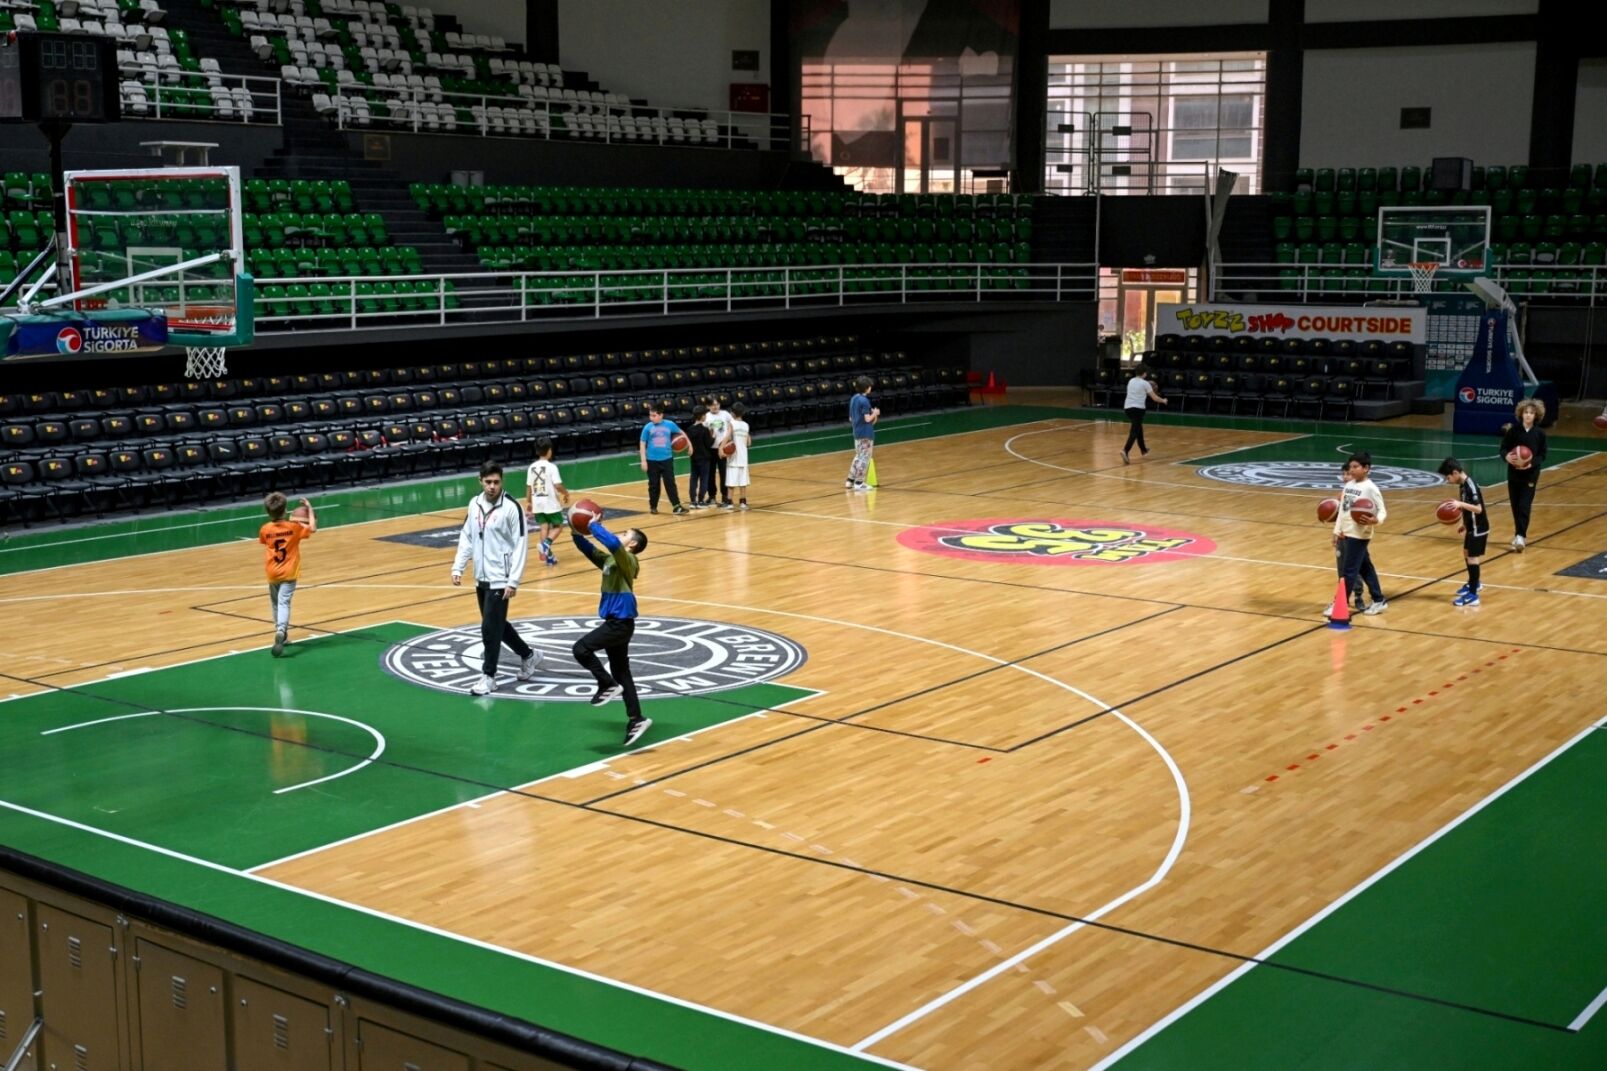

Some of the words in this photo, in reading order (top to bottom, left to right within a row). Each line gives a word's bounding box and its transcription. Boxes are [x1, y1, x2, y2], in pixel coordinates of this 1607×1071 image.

[1297, 315, 1412, 334] COURTSIDE
[273, 538, 287, 564] 5
[411, 653, 470, 679] TEA
[715, 634, 780, 675] BREW
